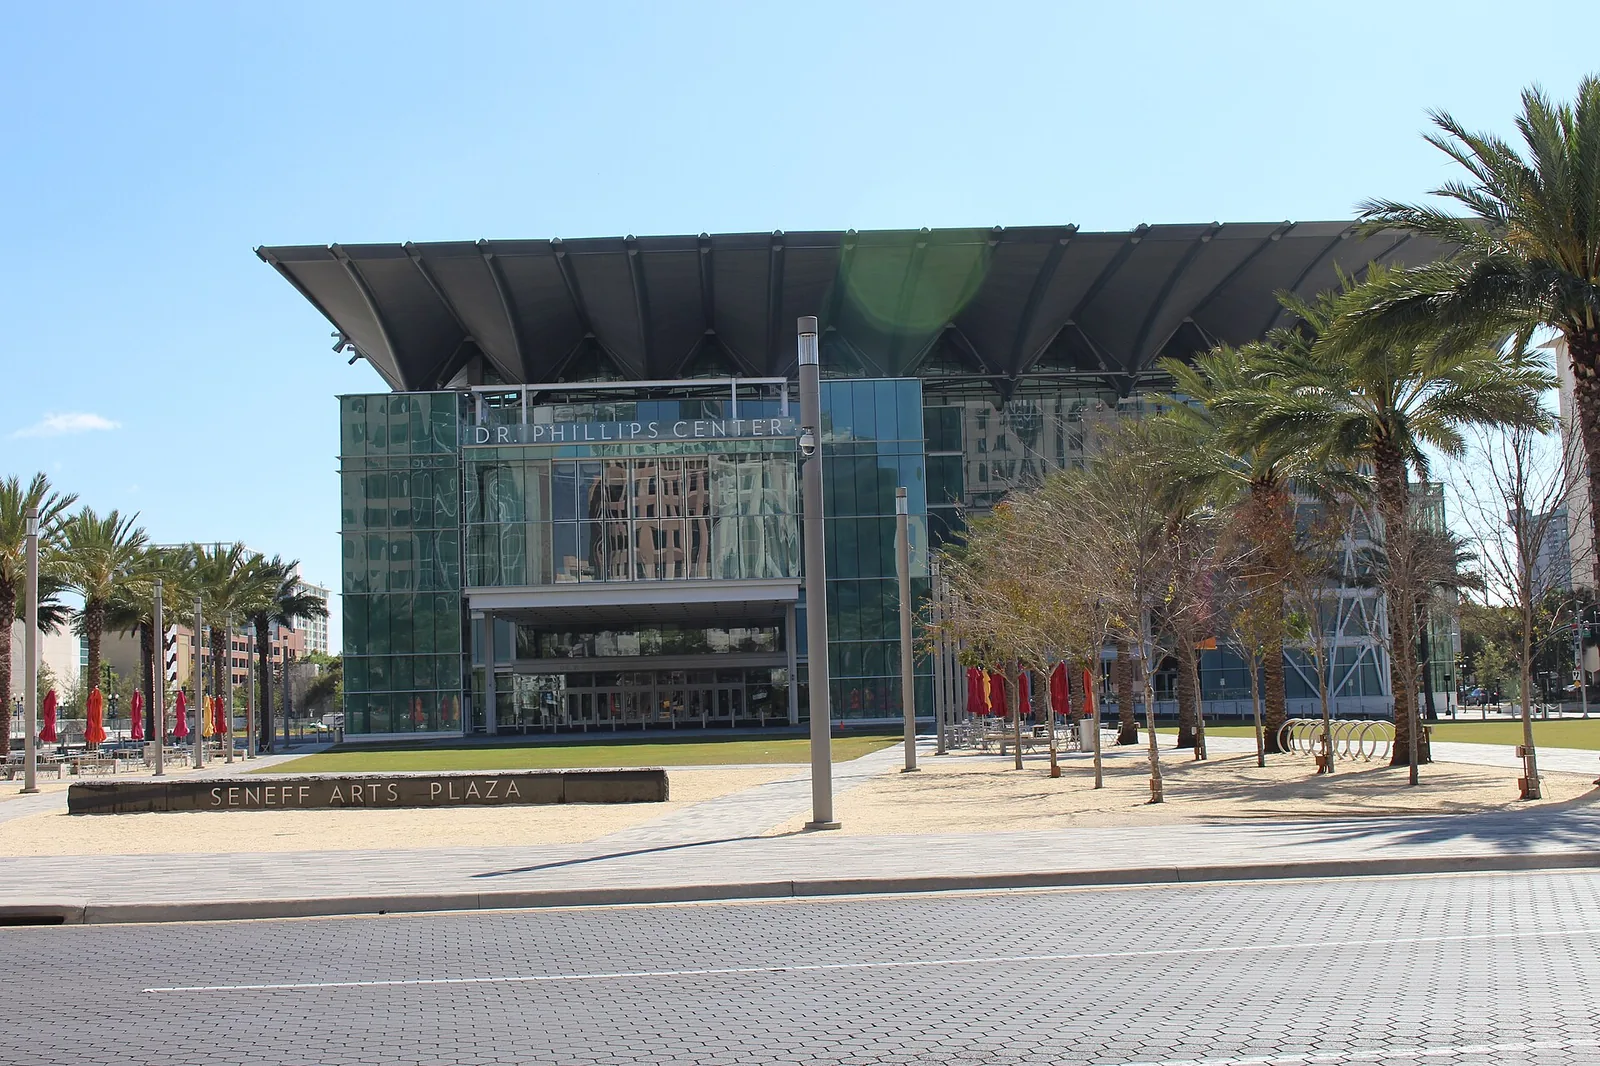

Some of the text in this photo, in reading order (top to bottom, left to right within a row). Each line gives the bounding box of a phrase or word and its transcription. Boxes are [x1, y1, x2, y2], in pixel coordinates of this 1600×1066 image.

[475, 418, 783, 444] DR. PHILLIPS CENTER
[210, 779, 521, 806] SENEFF ARTS PLAZA
